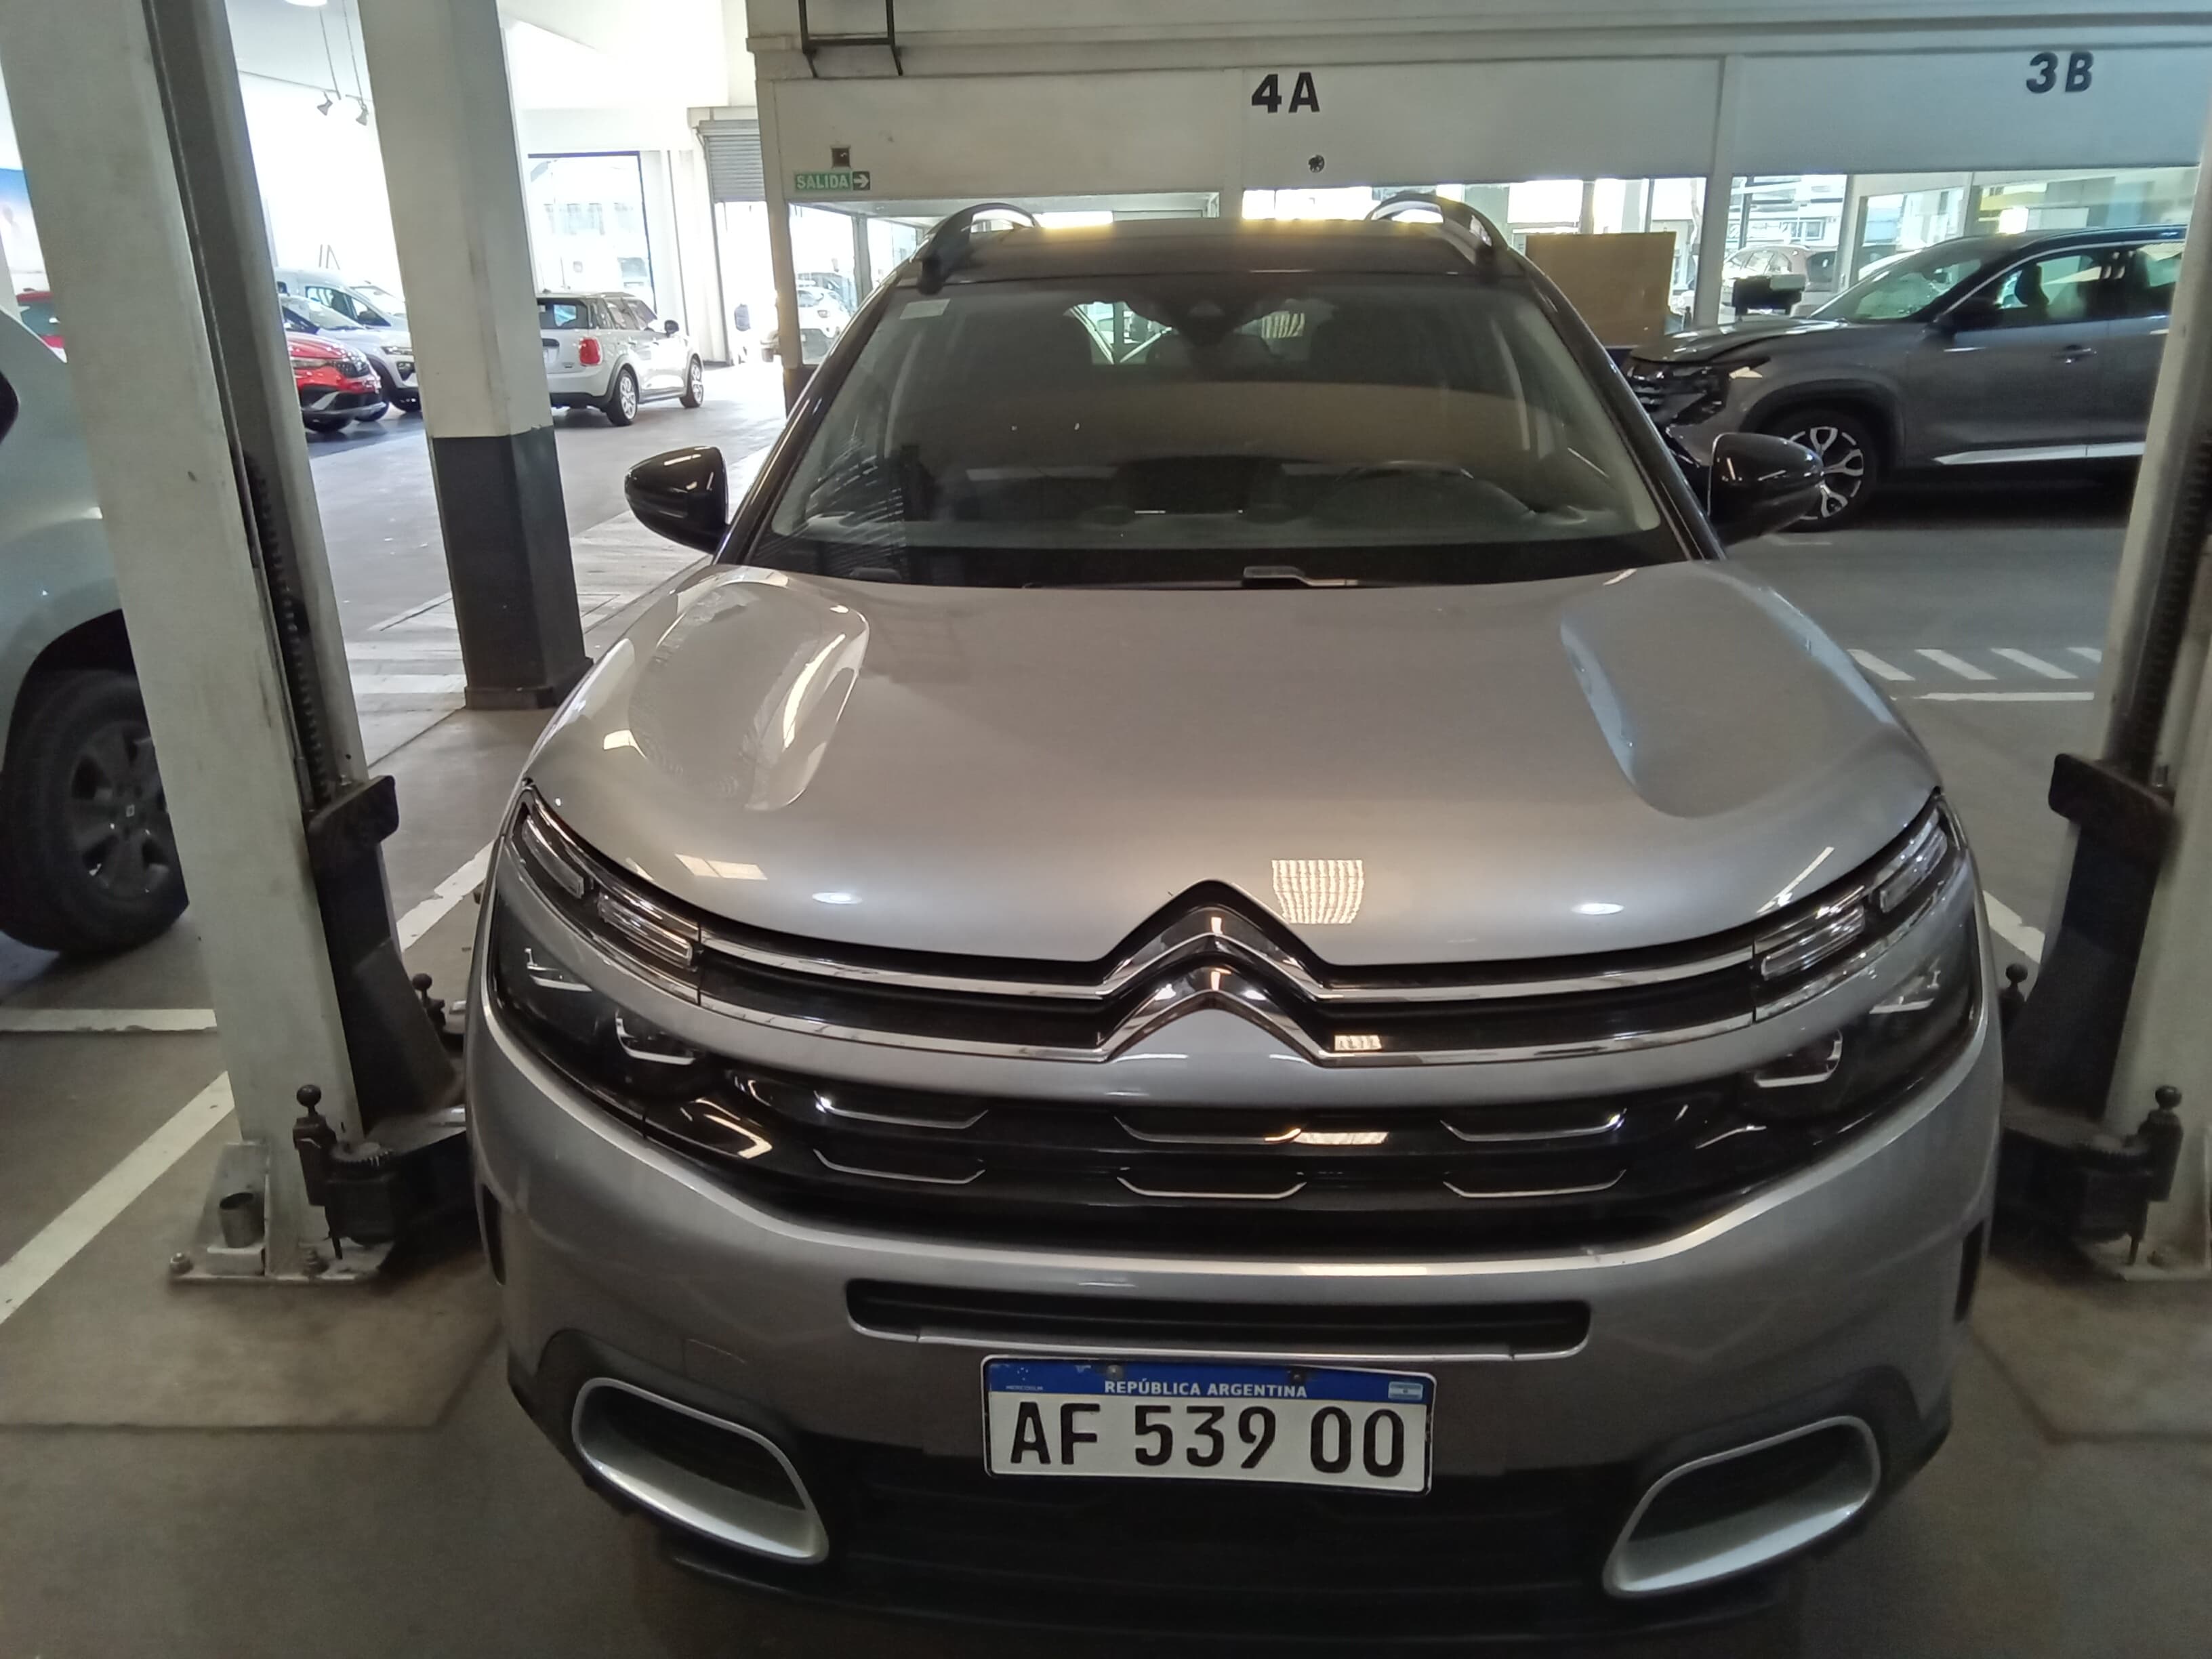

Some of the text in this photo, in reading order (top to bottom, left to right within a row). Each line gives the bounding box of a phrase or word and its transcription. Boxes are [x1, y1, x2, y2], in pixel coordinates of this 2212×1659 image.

[1252, 72, 1320, 113] 4A
[796, 174, 848, 189] SALIDA
[1104, 1378, 1307, 1398] REPÚBLICA ARGENTINA
[1010, 1401, 1101, 1465] AF
[1134, 1405, 1277, 1469] 539
